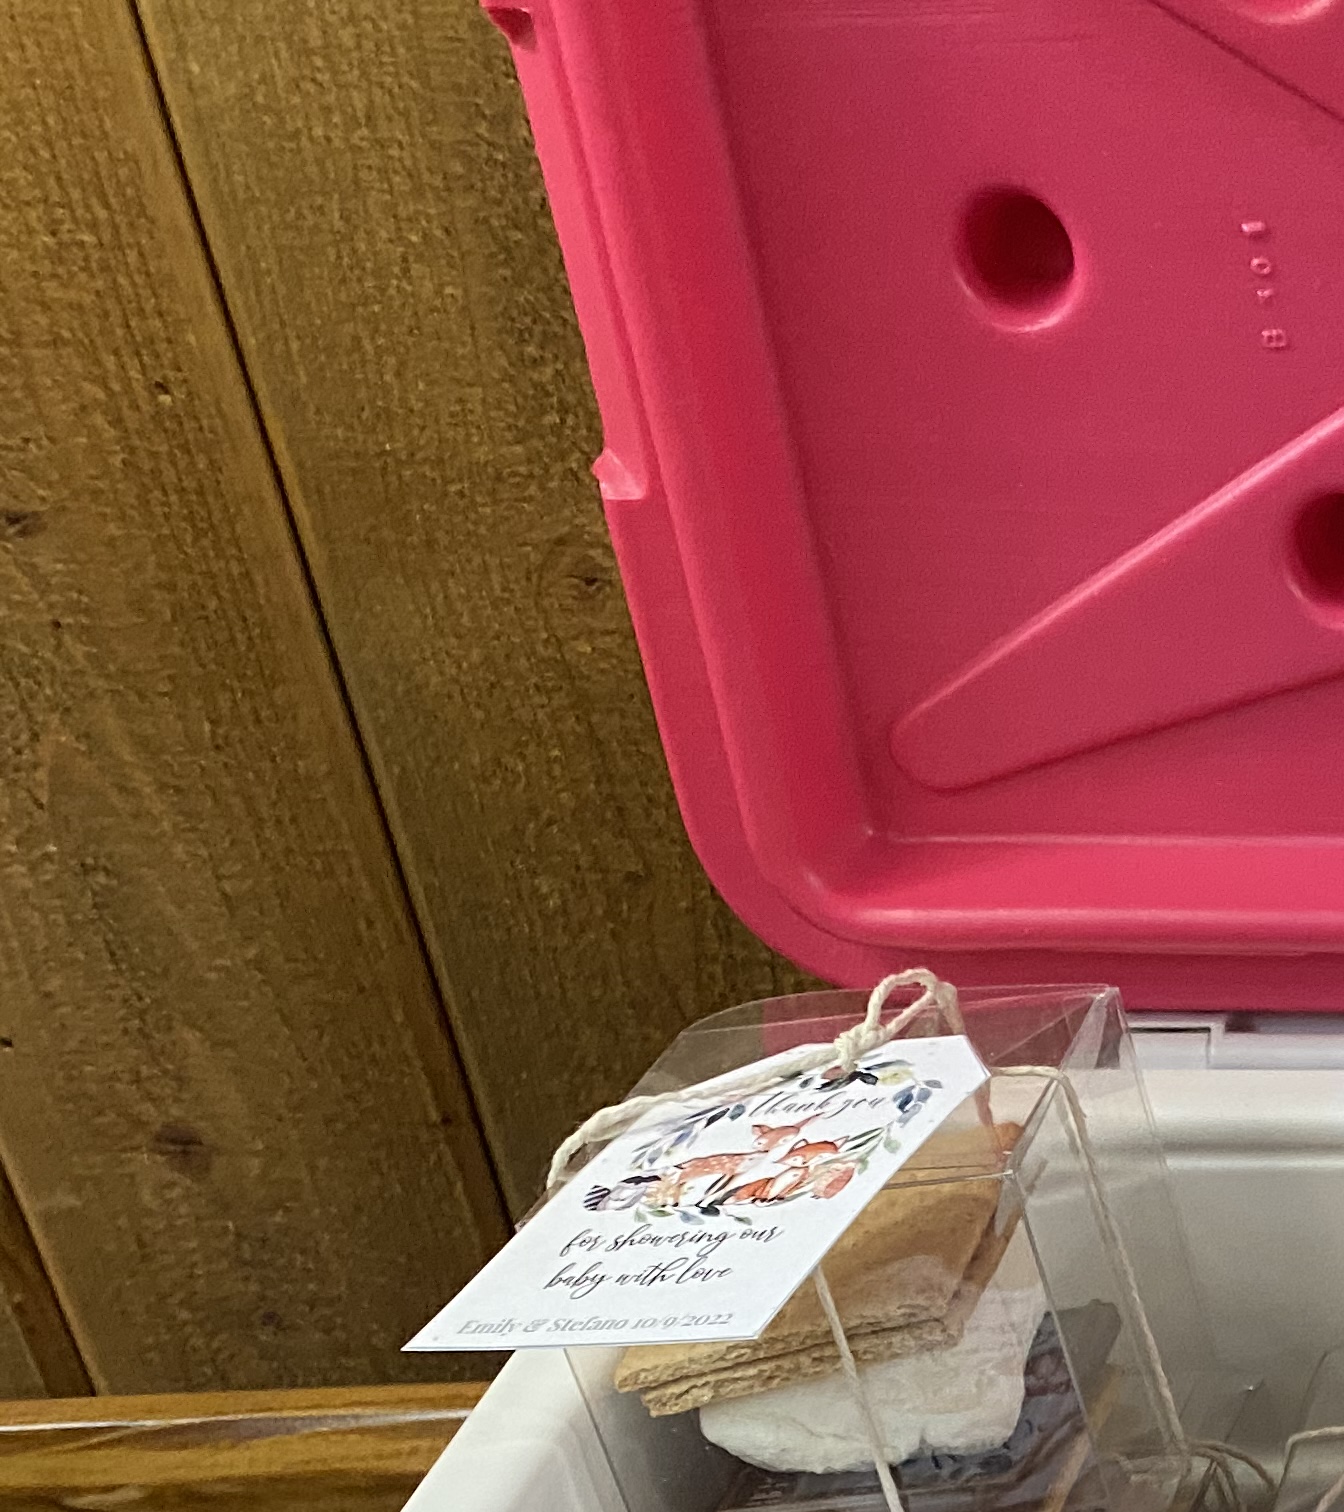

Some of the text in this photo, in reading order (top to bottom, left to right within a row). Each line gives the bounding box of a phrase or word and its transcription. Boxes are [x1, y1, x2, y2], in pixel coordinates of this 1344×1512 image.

[560, 1224, 785, 1261] for showering our
[542, 1255, 734, 1299] baby with love
[456, 1312, 734, 1337] Emily & Stefano 10/9/2022
